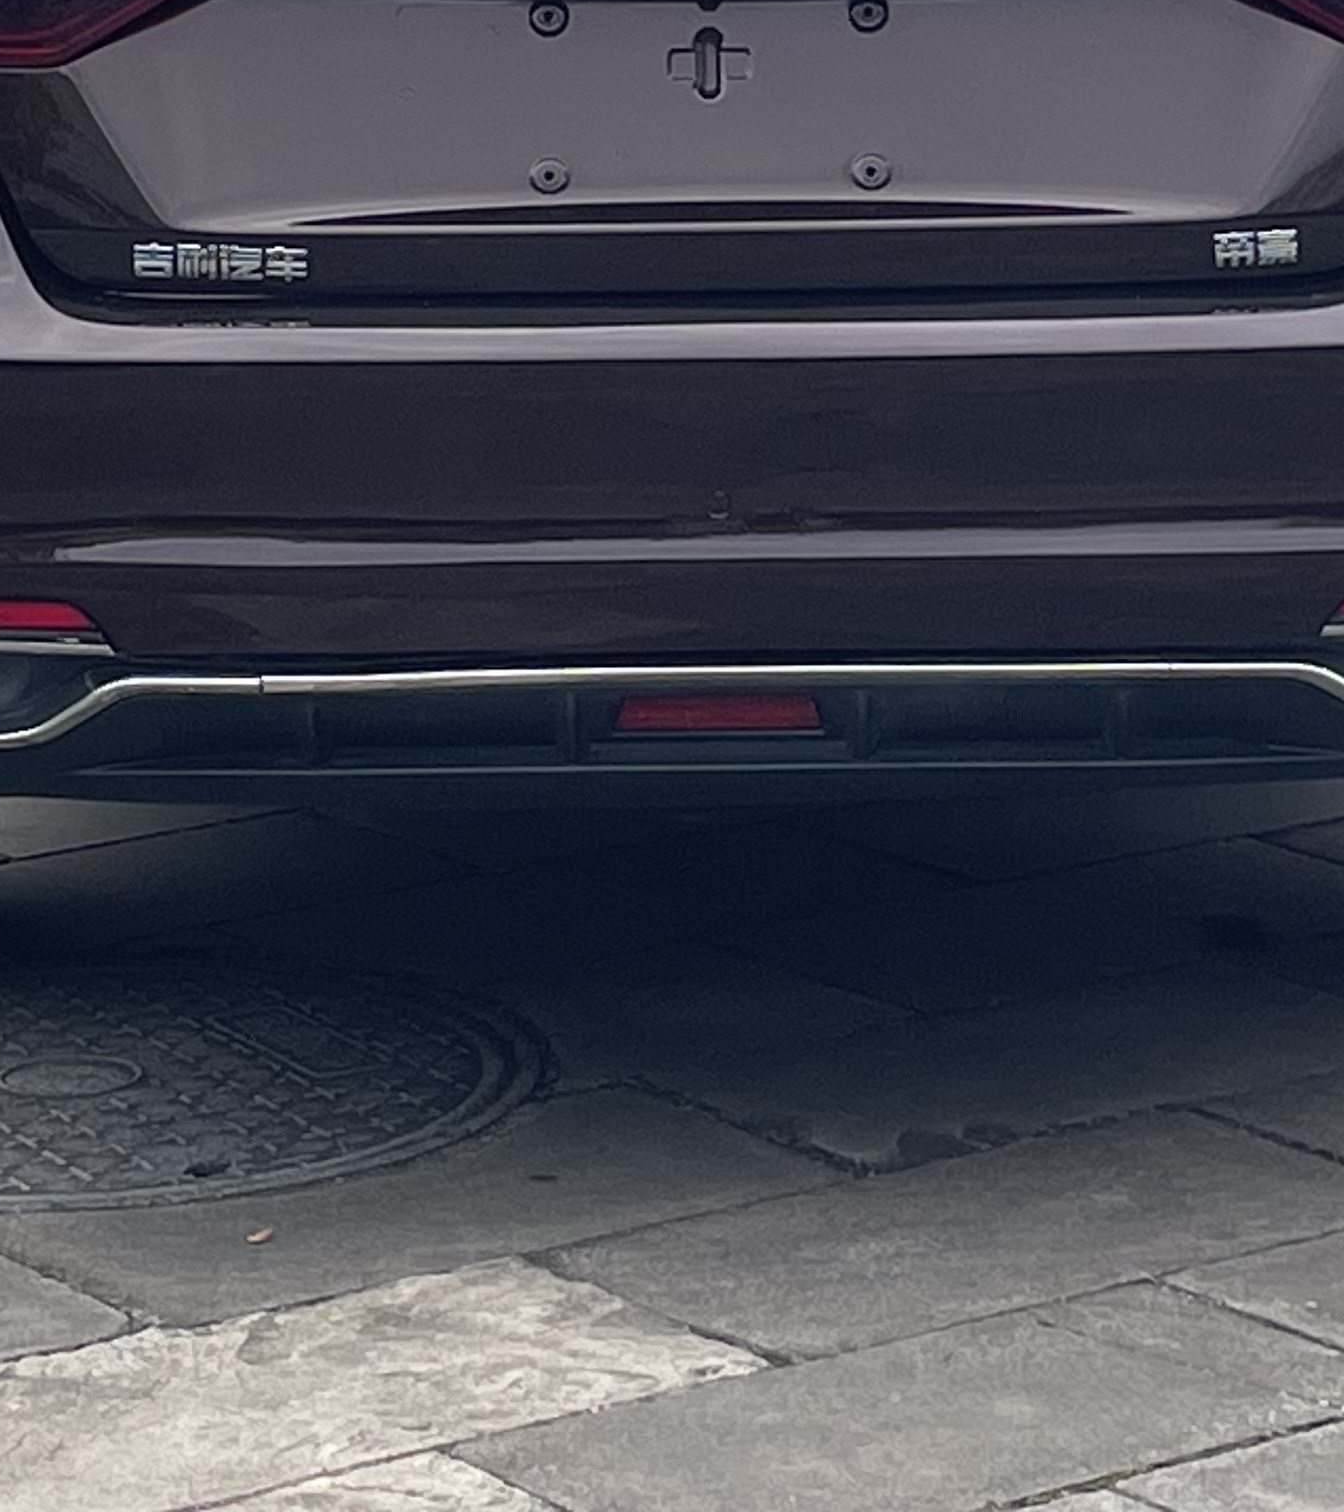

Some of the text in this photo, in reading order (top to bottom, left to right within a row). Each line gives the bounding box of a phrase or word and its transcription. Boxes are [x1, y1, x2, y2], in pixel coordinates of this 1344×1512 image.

[133, 242, 309, 282] 吉利汽车
[1213, 228, 1298, 268] 帝豪
